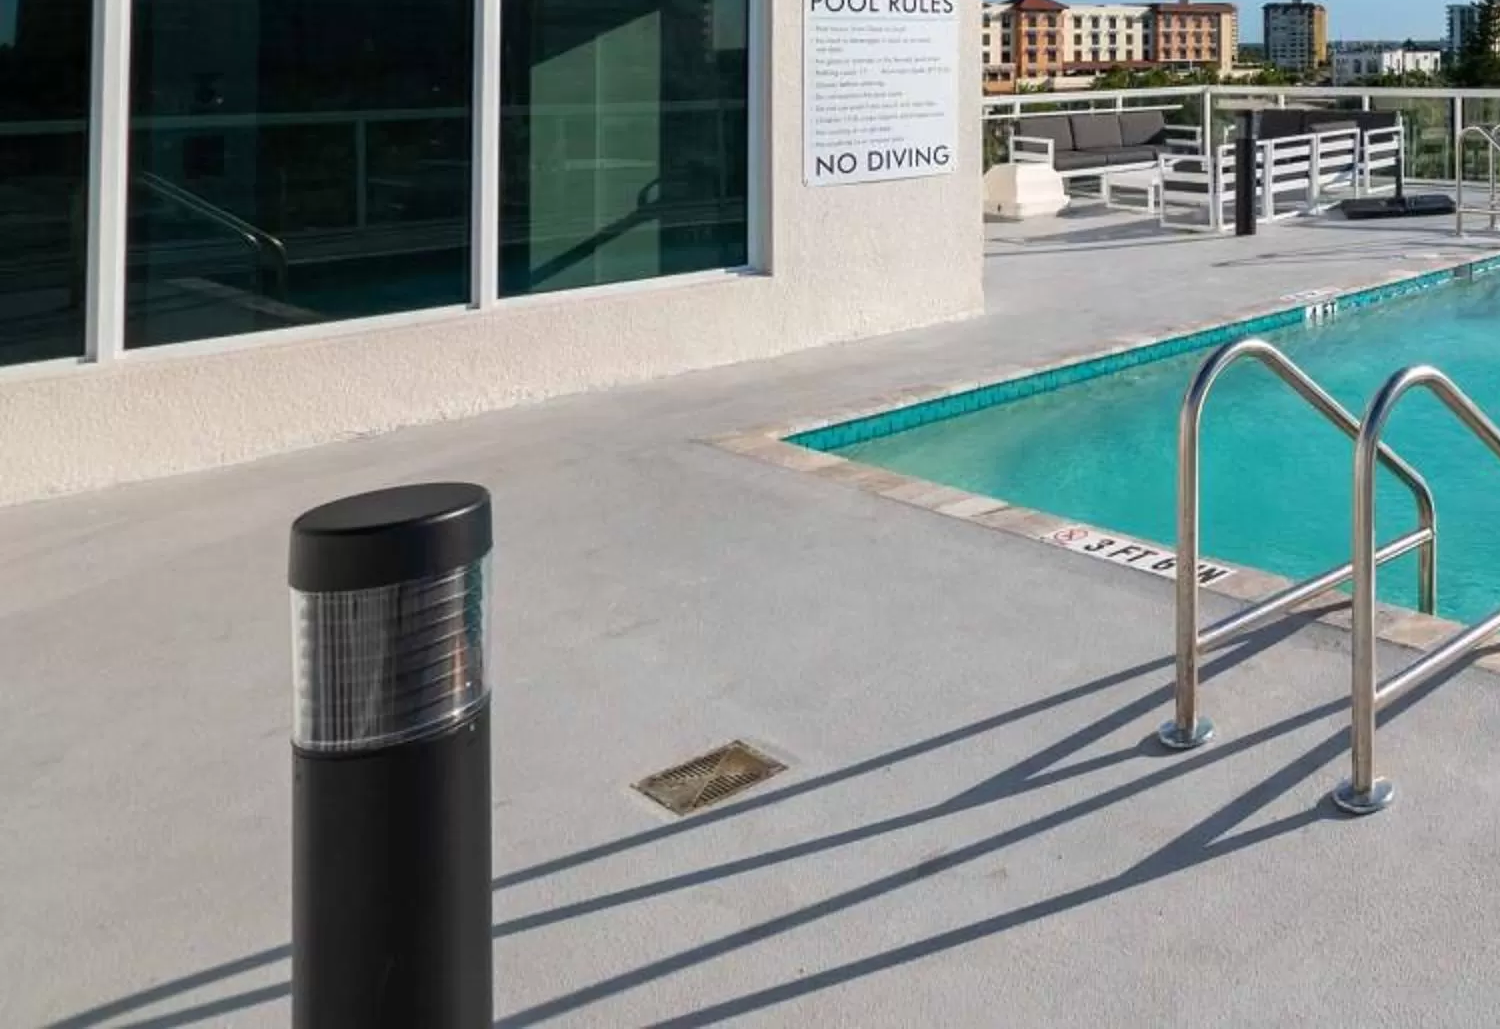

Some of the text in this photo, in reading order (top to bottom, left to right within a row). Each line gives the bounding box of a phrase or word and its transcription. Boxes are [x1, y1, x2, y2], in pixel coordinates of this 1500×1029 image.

[816, 144, 950, 176] NO DIVING
[1084, 538, 1115, 551] 3
[1106, 545, 1159, 562] FT
[1151, 557, 1177, 570] 6
